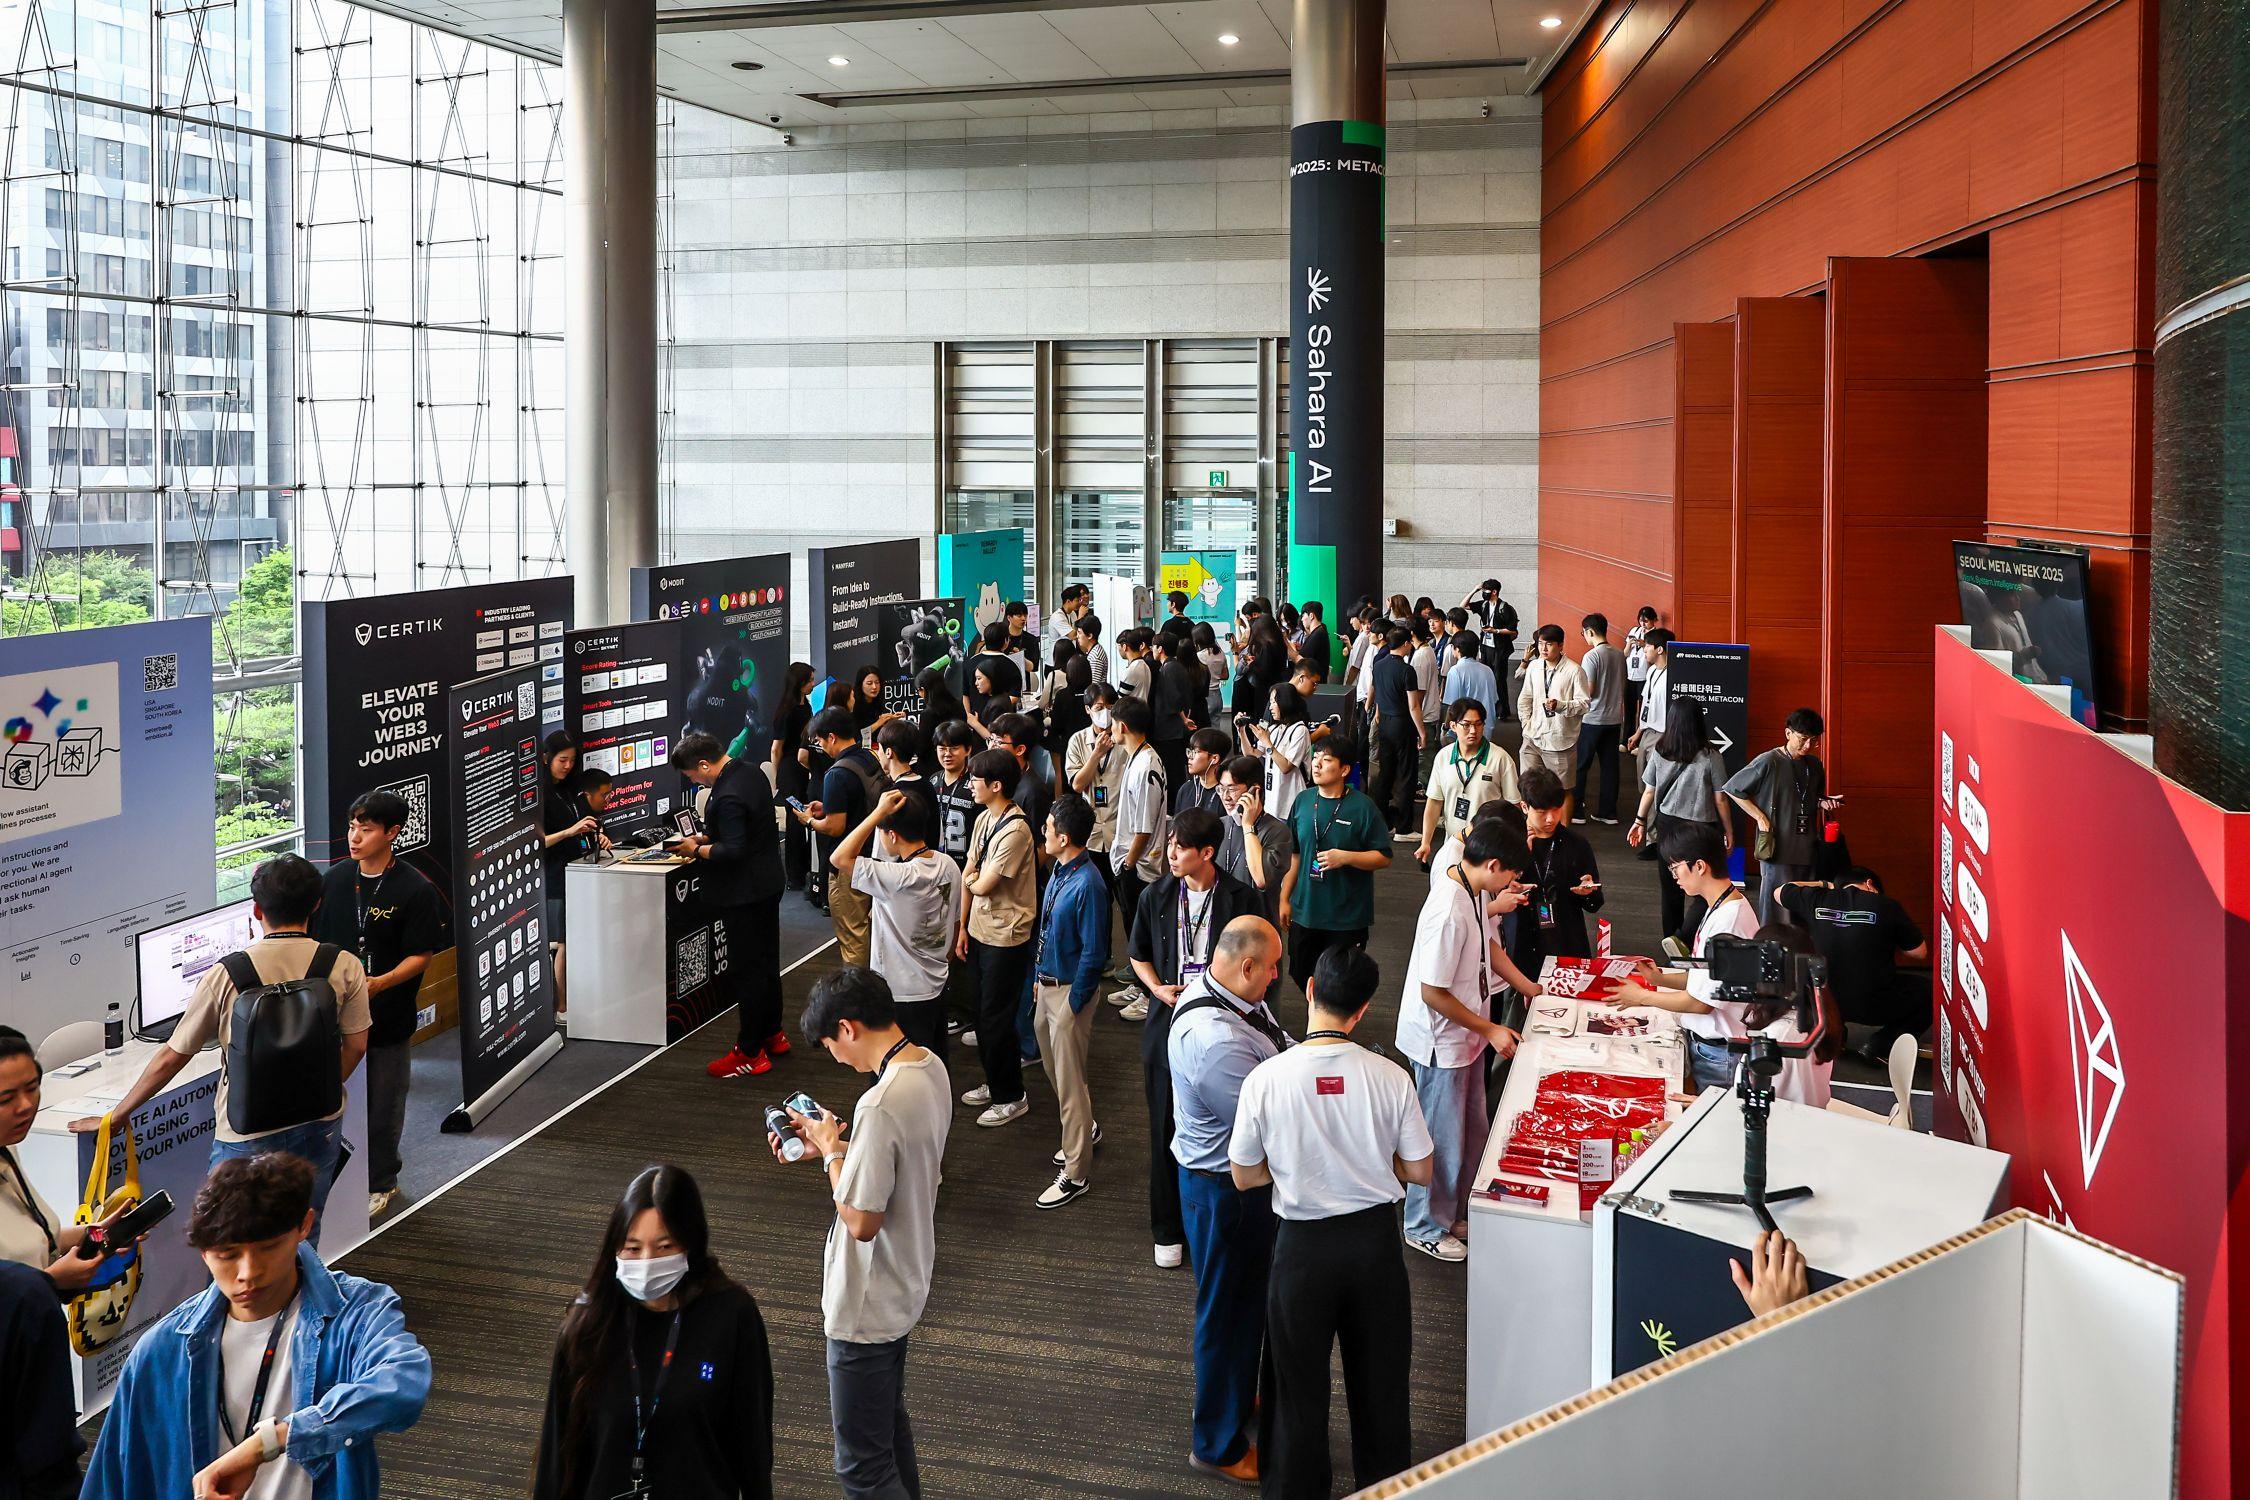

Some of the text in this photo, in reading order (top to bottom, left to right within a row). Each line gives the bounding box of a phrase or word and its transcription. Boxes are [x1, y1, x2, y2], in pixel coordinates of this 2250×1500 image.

[1307, 324, 1332, 493] Sahara AI
[1960, 555, 2064, 582] SEOUL META WEEK 2025
[832, 581, 870, 596] From Idea to
[484, 604, 531, 616] INDUSTRY LEADING
[832, 596, 869, 614] Build-Ready
[484, 614, 510, 623] PARTNERS
[515, 611, 535, 619] CLIENTS
[832, 616, 859, 632] Instantly
[377, 618, 443, 639] CERTIK
[588, 637, 619, 646] CERTIK
[599, 660, 617, 668] Rating
[361, 681, 439, 709] ELEVATE
[1672, 683, 1721, 693] 서울메타위크
[474, 691, 513, 713] CERTIK
[599, 700, 612, 708] Tools
[1708, 695, 1744, 703] METACON
[144, 703, 175, 713] SINGAPORE
[145, 709, 182, 720] SOUTH KOREA
[376, 702, 425, 725] YOUR
[374, 720, 428, 744] WEB3
[463, 728, 479, 739] Elevate
[479, 725, 488, 733] Your
[601, 736, 616, 744] Quest
[358, 734, 443, 767] JOURNEY
[615, 780, 653, 796] Platform for
[619, 793, 648, 805] Security
[16, 803, 49, 815] assistant
[18, 812, 57, 827] processes
[1, 841, 69, 864] instructions and
[11, 866, 29, 876] you.
[31, 860, 45, 869] We
[46, 857, 60, 866] are
[39, 872, 48, 881] AI
[50, 865, 73, 878] agent
[4, 885, 50, 904] ask human
[10, 903, 35, 915] tasks.
[120, 914, 137, 923] Natural
[107, 923, 130, 934] Language
[59, 932, 90, 946] Time-Saving
[11, 945, 40, 958] Actionable
[15, 953, 36, 963] Insights
[152, 1104, 166, 1120] AI
[147, 1112, 190, 1141] USING
[135, 1137, 173, 1165] YOUR
